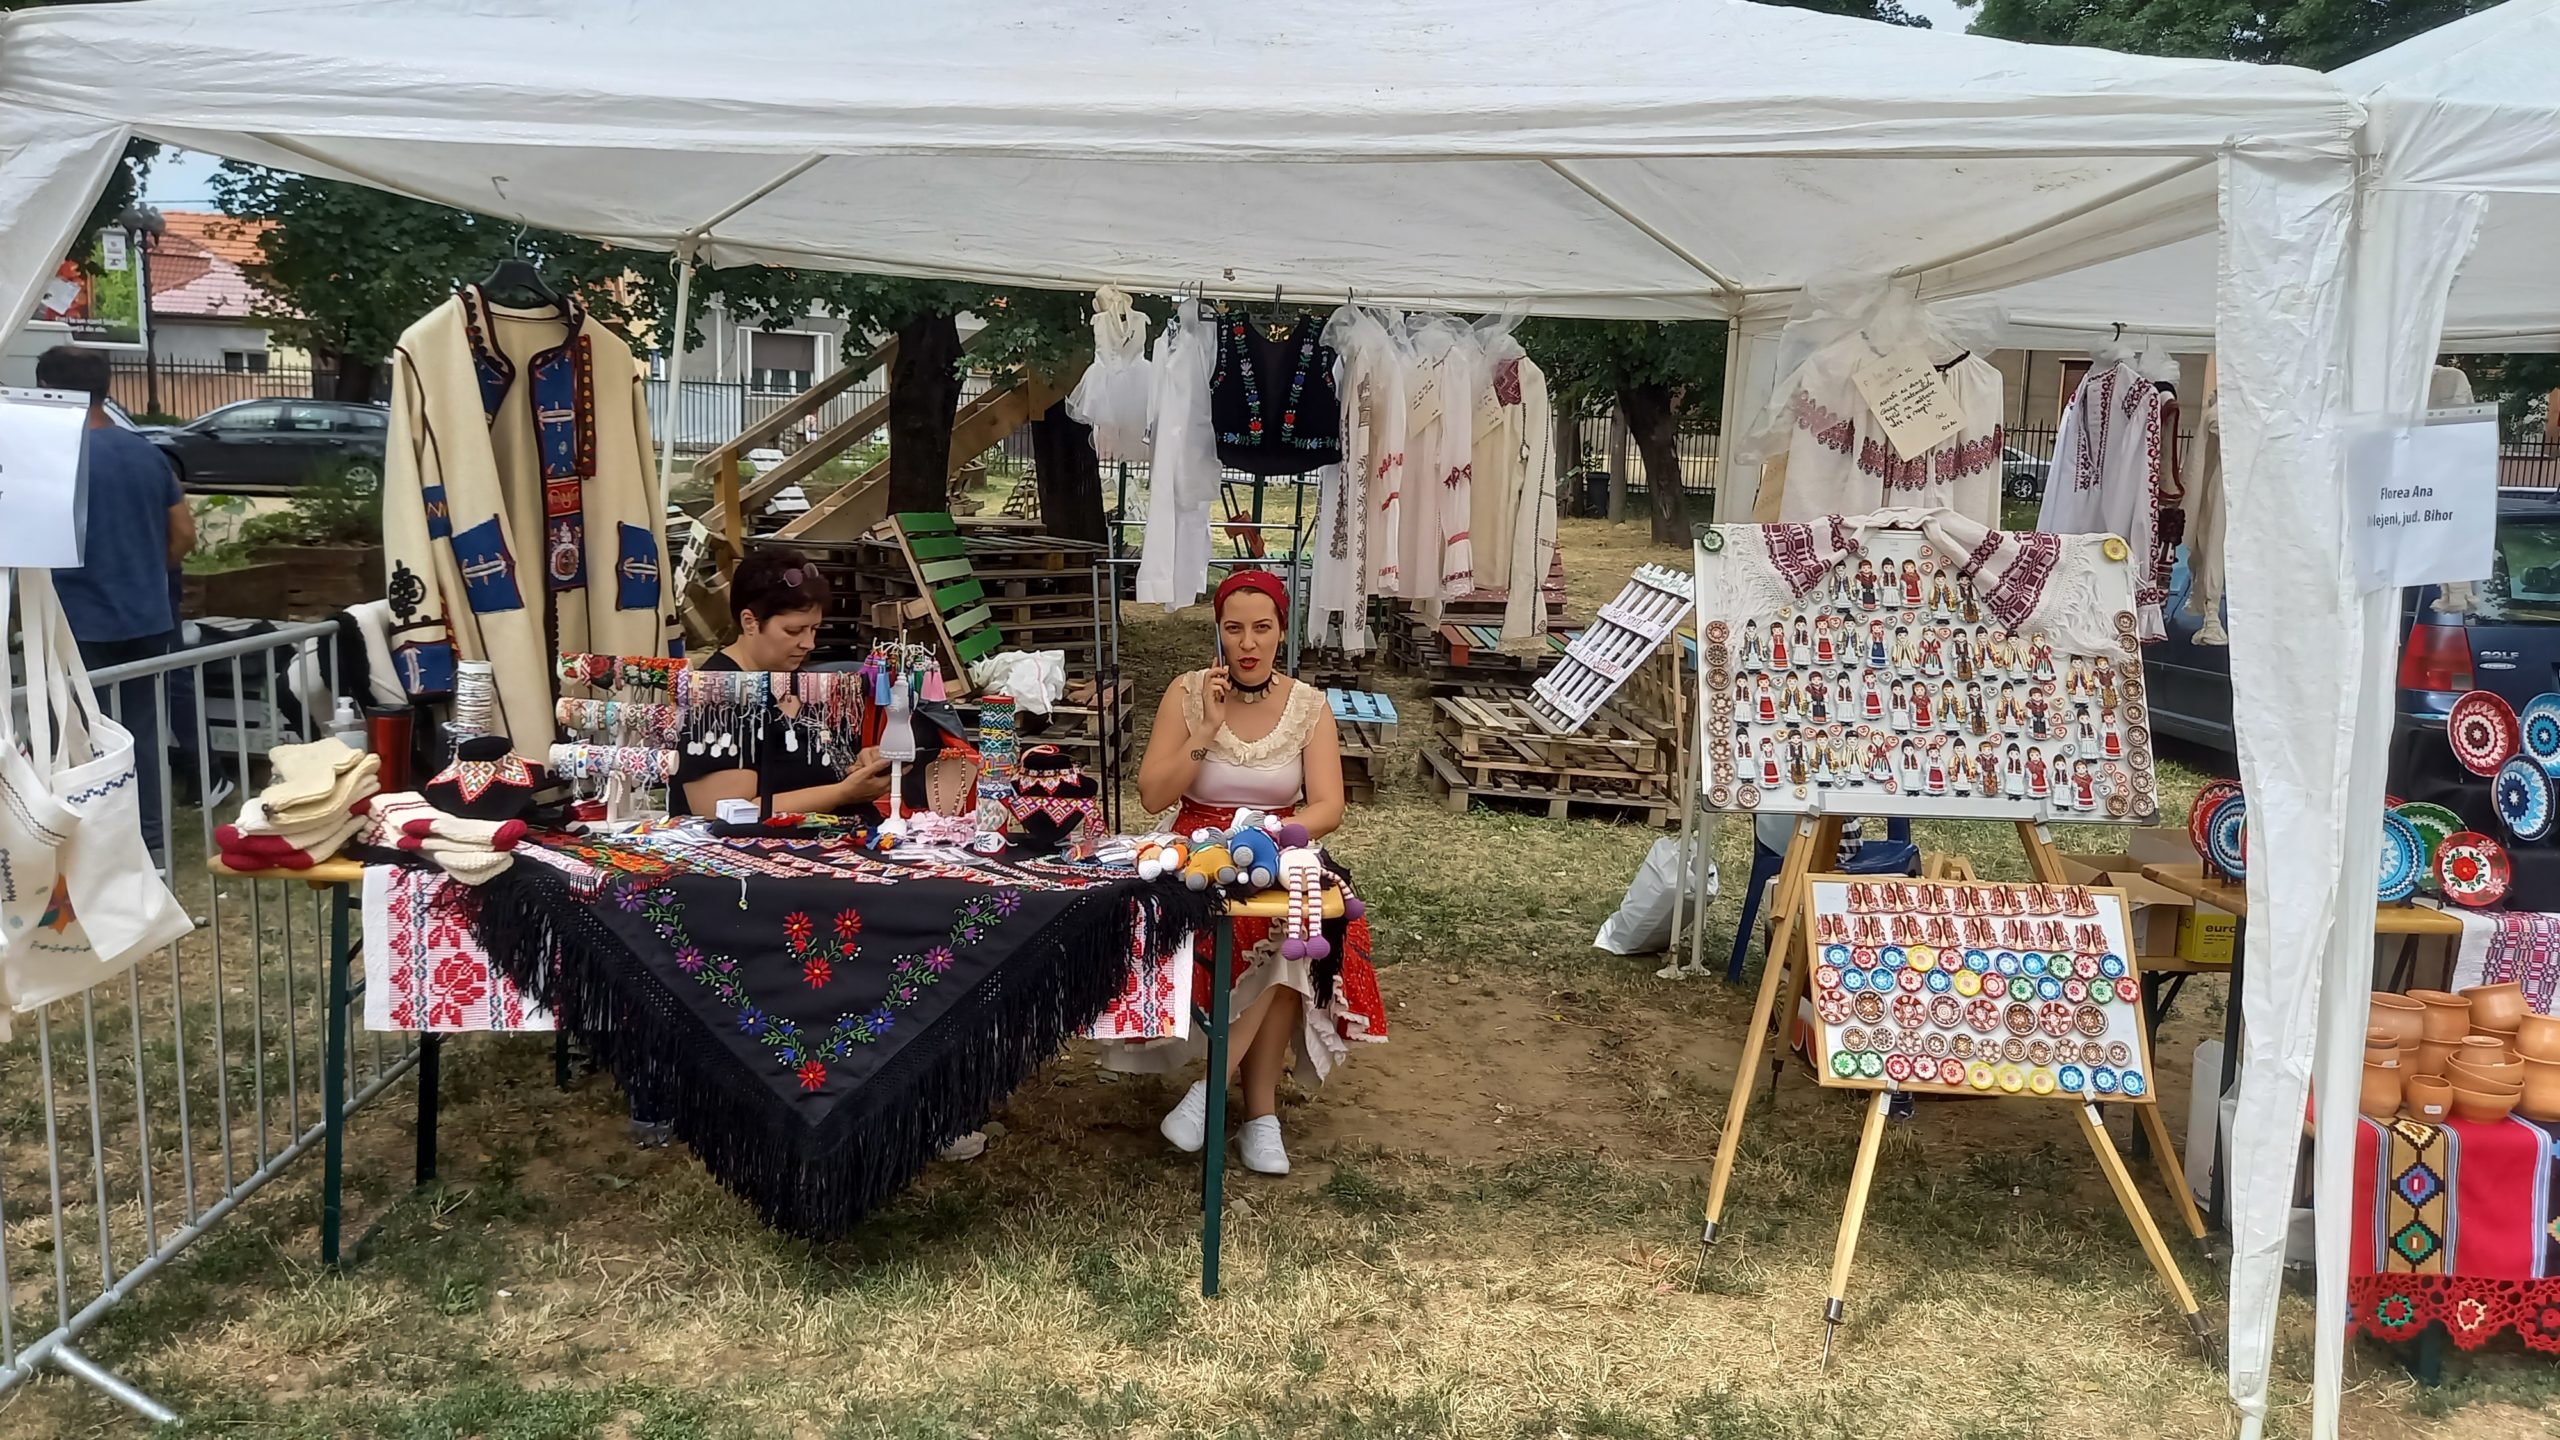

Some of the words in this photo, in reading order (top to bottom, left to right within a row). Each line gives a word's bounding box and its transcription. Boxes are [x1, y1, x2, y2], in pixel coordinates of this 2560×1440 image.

[2380, 487, 2410, 500] Florea
[2411, 485, 2433, 498] Ana
[2401, 509, 2421, 527] jud.
[2423, 508, 2453, 522] Bihor
[2480, 651, 2519, 660] GOLF
